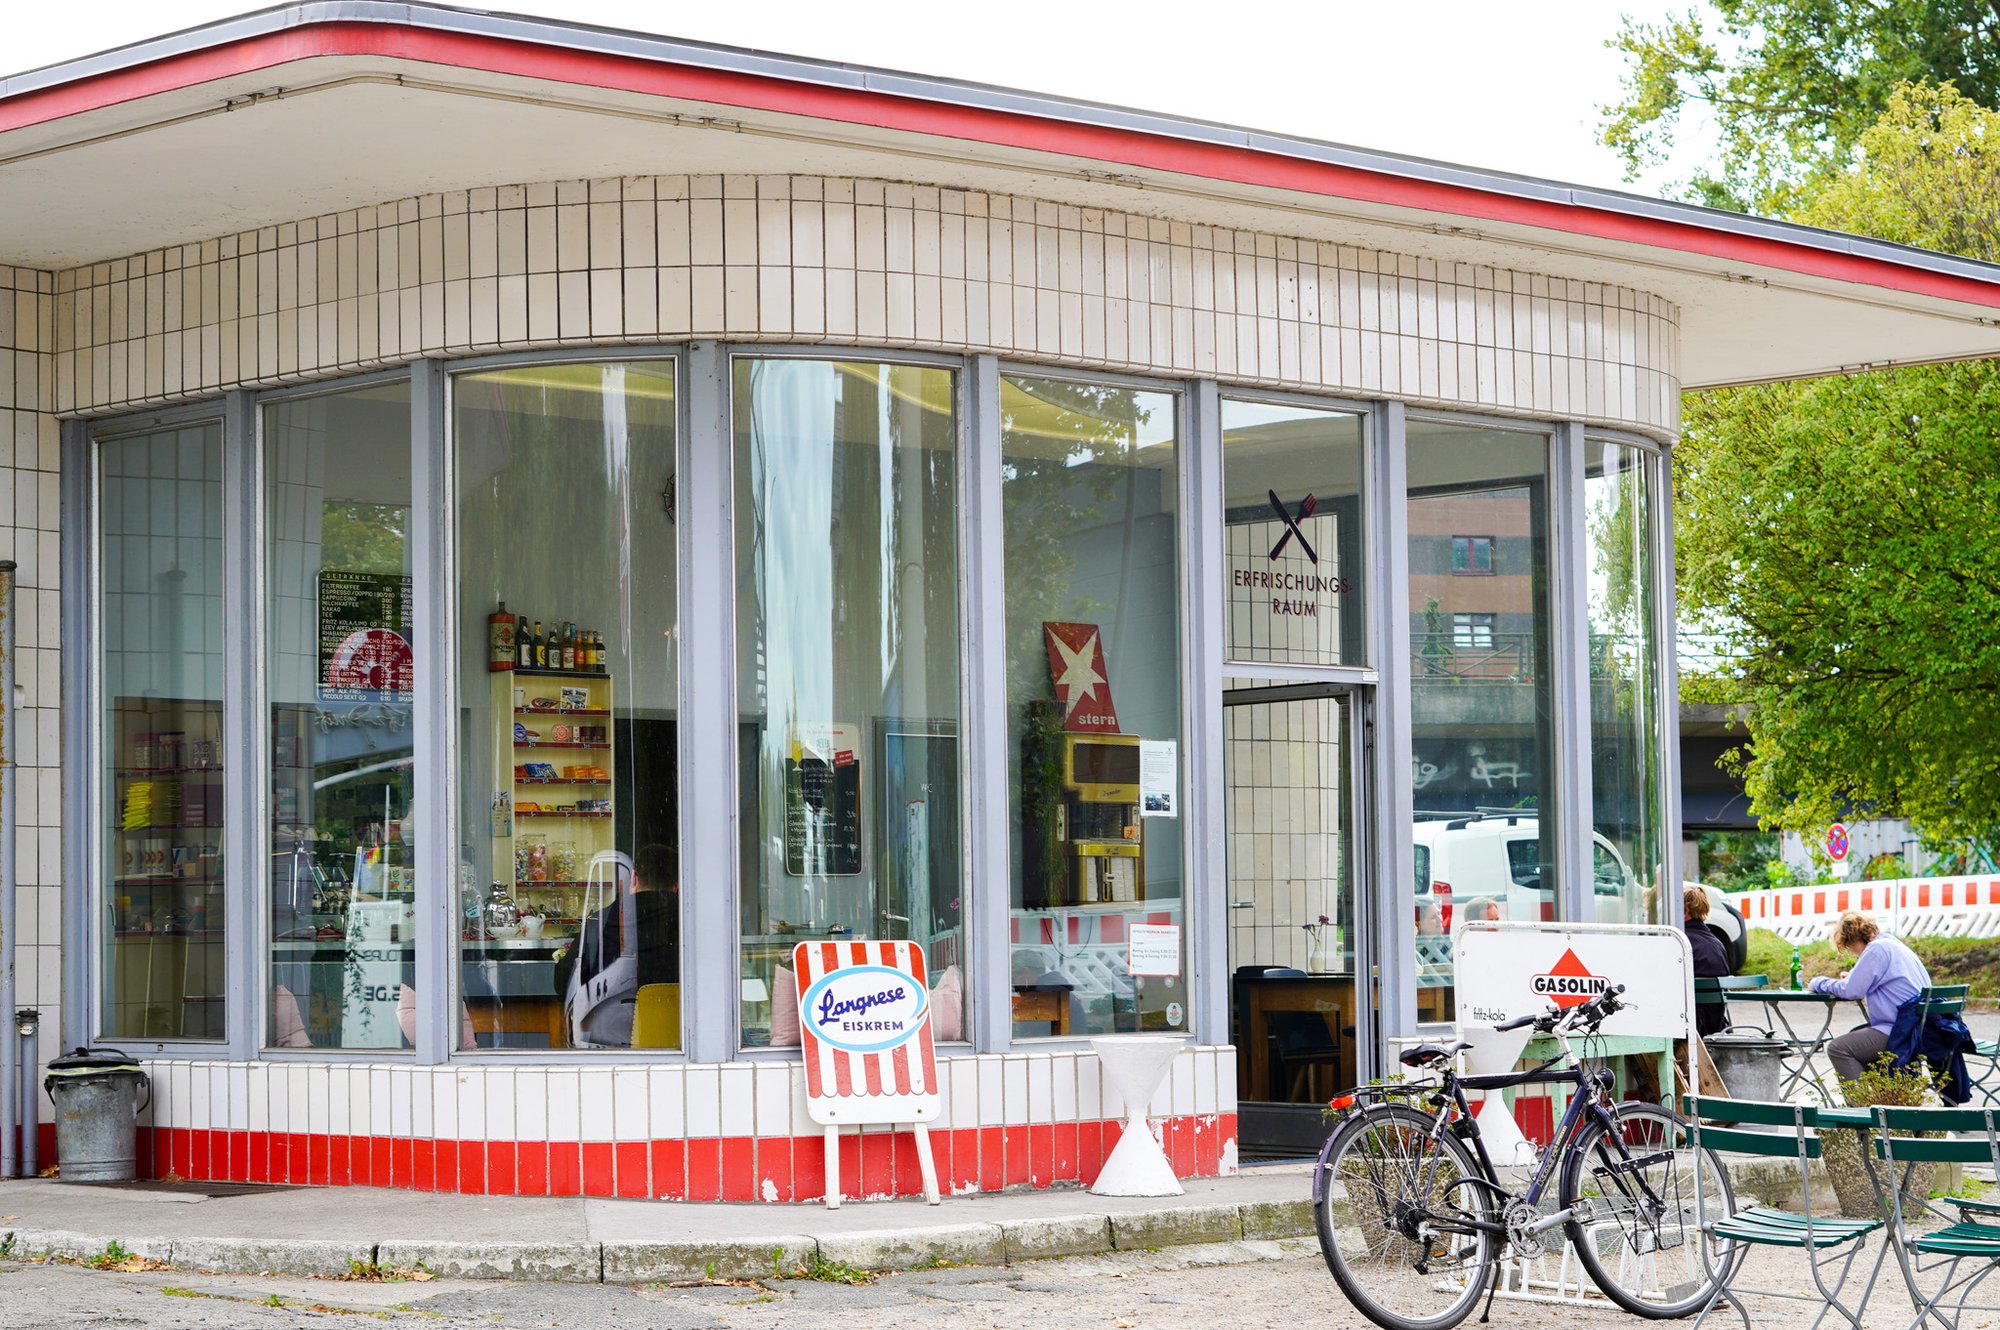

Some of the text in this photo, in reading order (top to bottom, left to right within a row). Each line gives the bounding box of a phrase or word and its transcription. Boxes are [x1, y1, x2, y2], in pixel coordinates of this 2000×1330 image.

[1273, 598, 1317, 617] RAUM
[1078, 712, 1116, 725] stern
[1534, 977, 1605, 994] GASOLIN
[818, 987, 906, 1027] Langnese
[1473, 1006, 1506, 1021] fritz-kola
[843, 1021, 904, 1031] EISKREM
